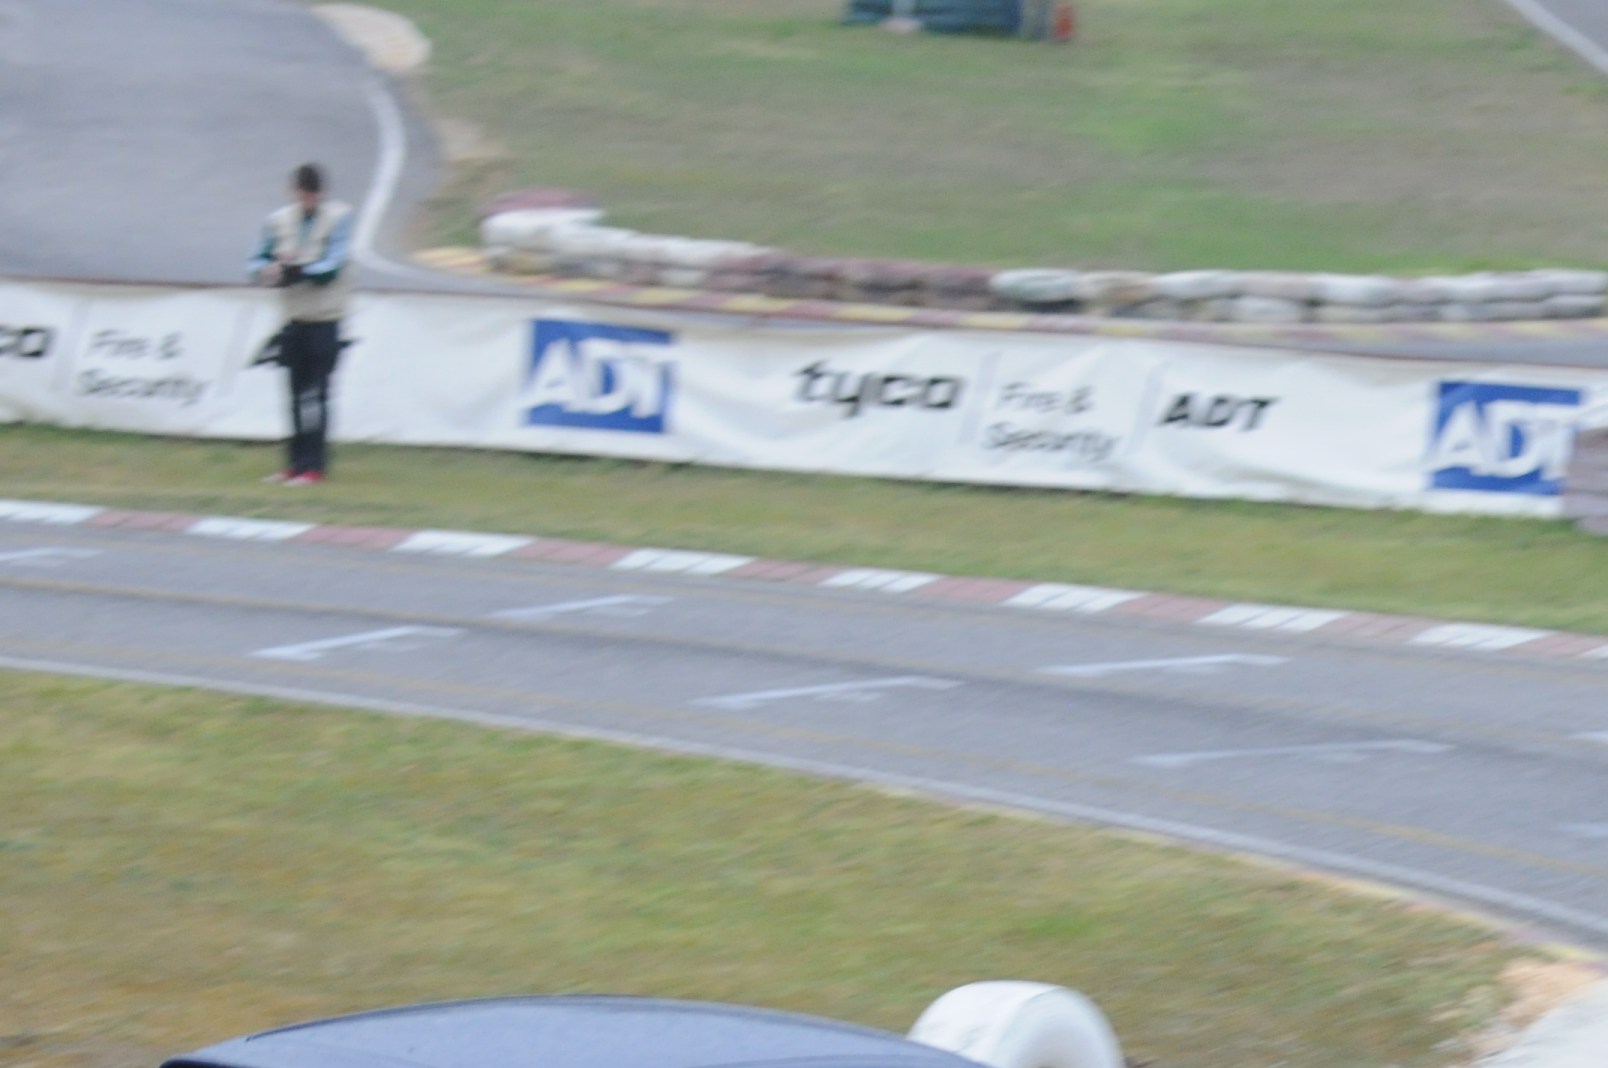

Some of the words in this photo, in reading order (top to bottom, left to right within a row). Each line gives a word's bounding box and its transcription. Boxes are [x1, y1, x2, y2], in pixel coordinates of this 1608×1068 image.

[527, 335, 673, 419] ADT
[794, 359, 968, 419] tyco
[1157, 392, 1280, 433] ADT
[1428, 399, 1582, 480] ADT
